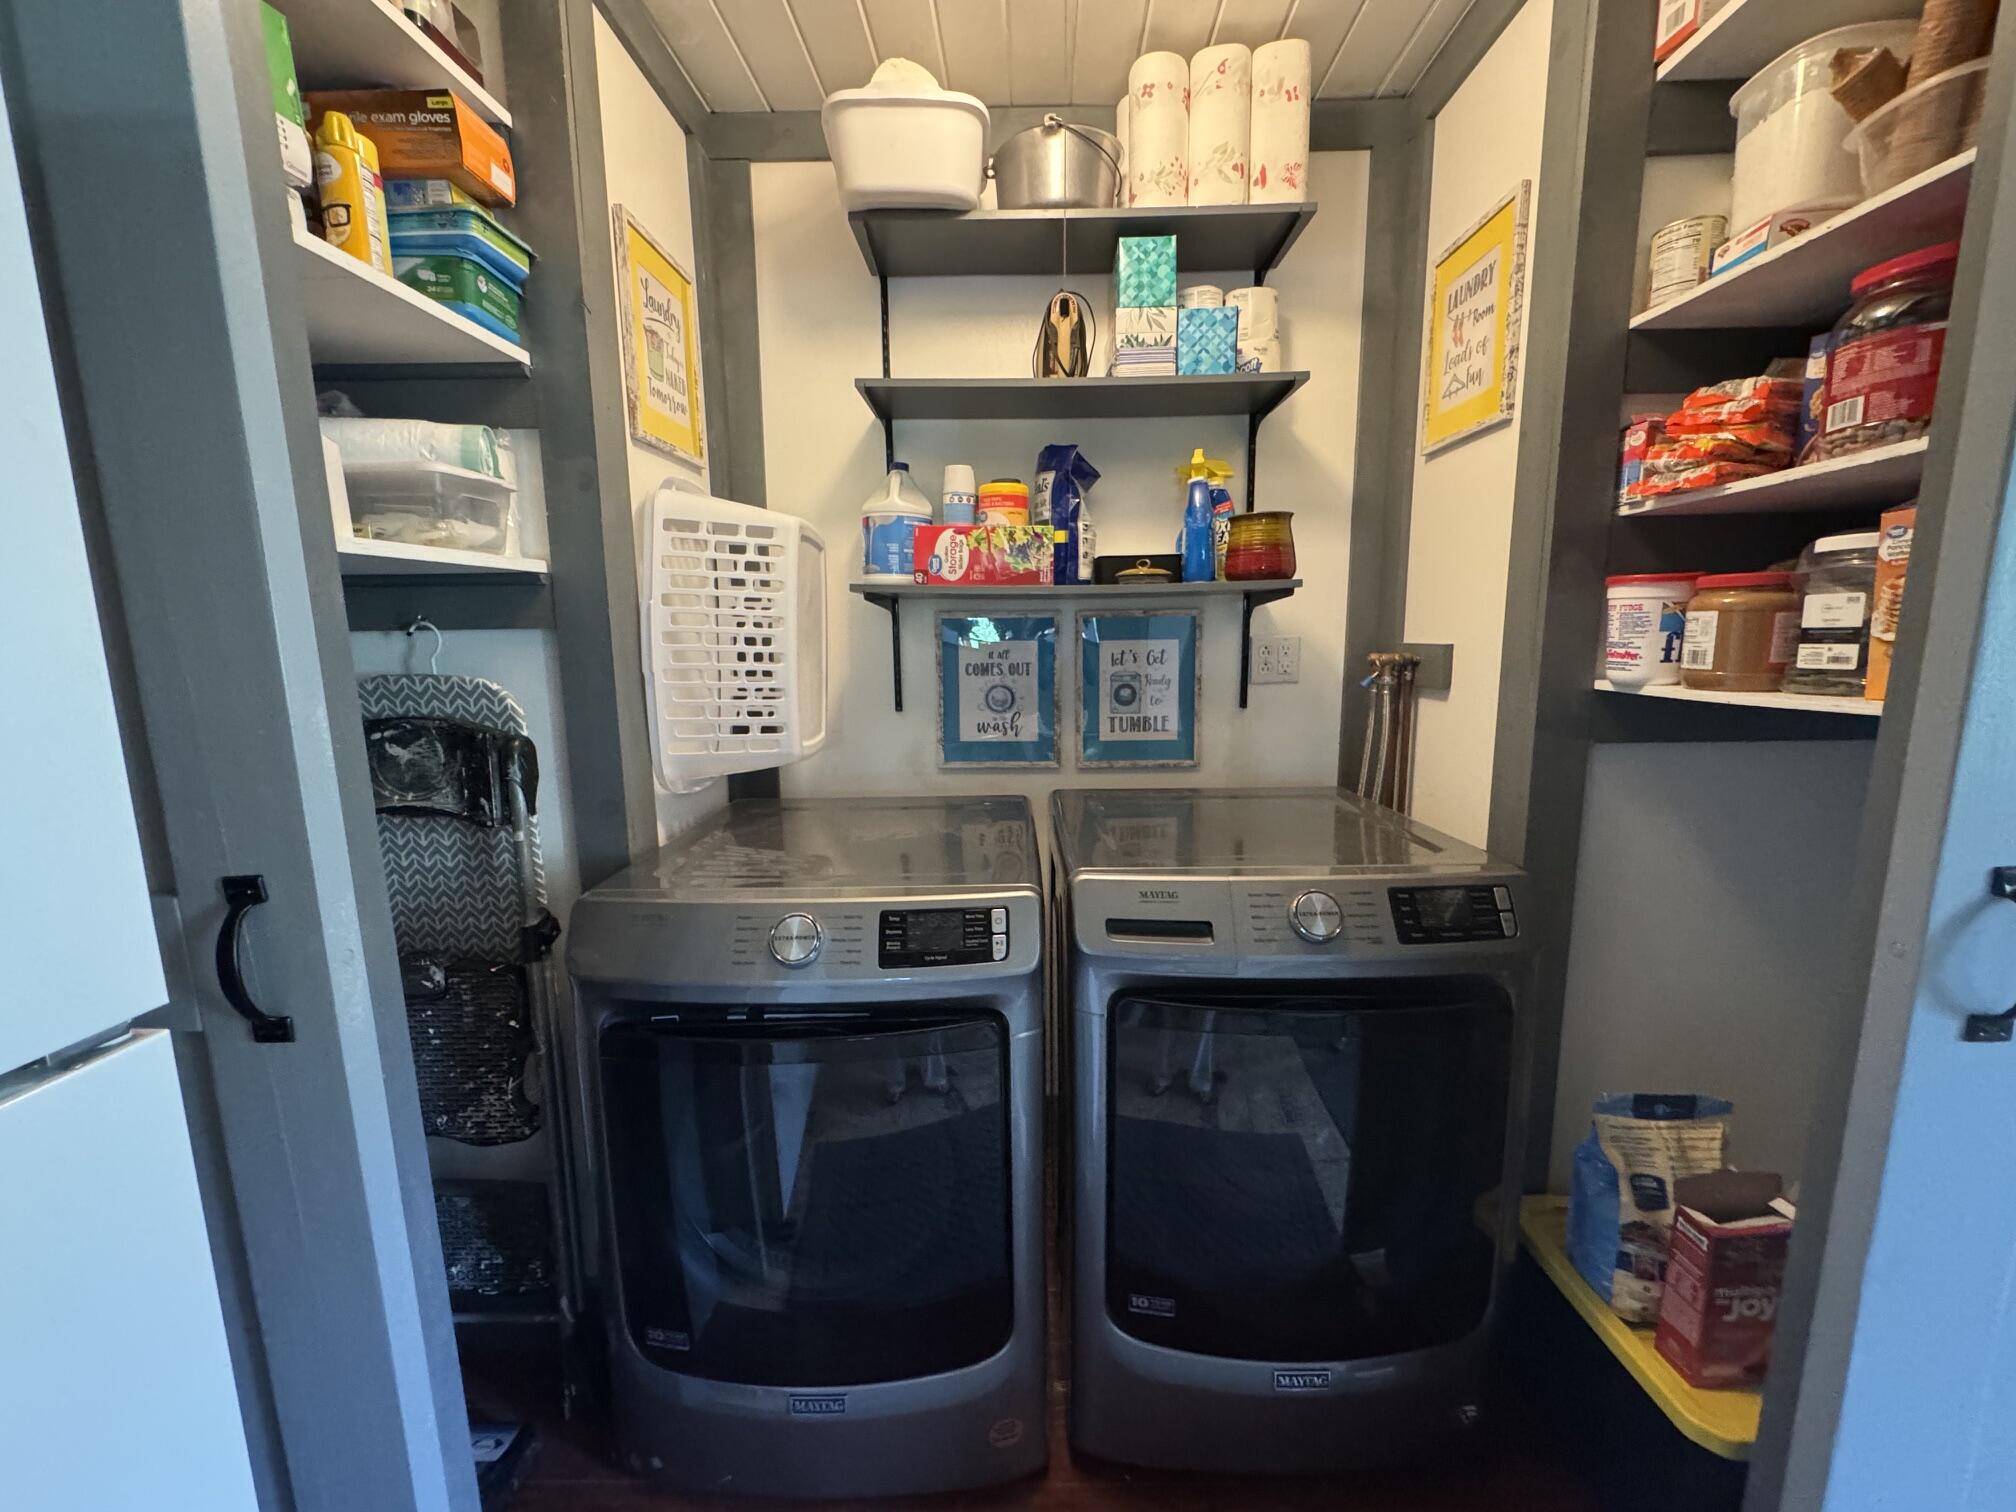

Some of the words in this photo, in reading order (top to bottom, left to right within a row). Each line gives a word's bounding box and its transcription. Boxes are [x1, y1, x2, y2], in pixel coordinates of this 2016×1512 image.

[370, 112, 406, 123] exam
[408, 110, 451, 126] gloves
[1447, 258, 1498, 315] LAUNDRY
[640, 277, 681, 344] Laundry
[1472, 302, 1496, 325] Room
[1442, 337, 1474, 376] Loads
[1475, 334, 1491, 357] of
[665, 368, 686, 396] NAKED
[648, 376, 687, 415] Tomorrow
[948, 534, 960, 576] Storage
[915, 571, 924, 584] 40
[1146, 648, 1166, 666] Get
[965, 662, 1004, 677] COMES
[1007, 662, 1032, 677] OUT
[976, 711, 1023, 738] wash
[1107, 715, 1170, 734] TUMBLE
[1138, 890, 1180, 900] MAYTAG
[1277, 1375, 1329, 1387] MAYTAG
[793, 1399, 844, 1412] MAYTAG
